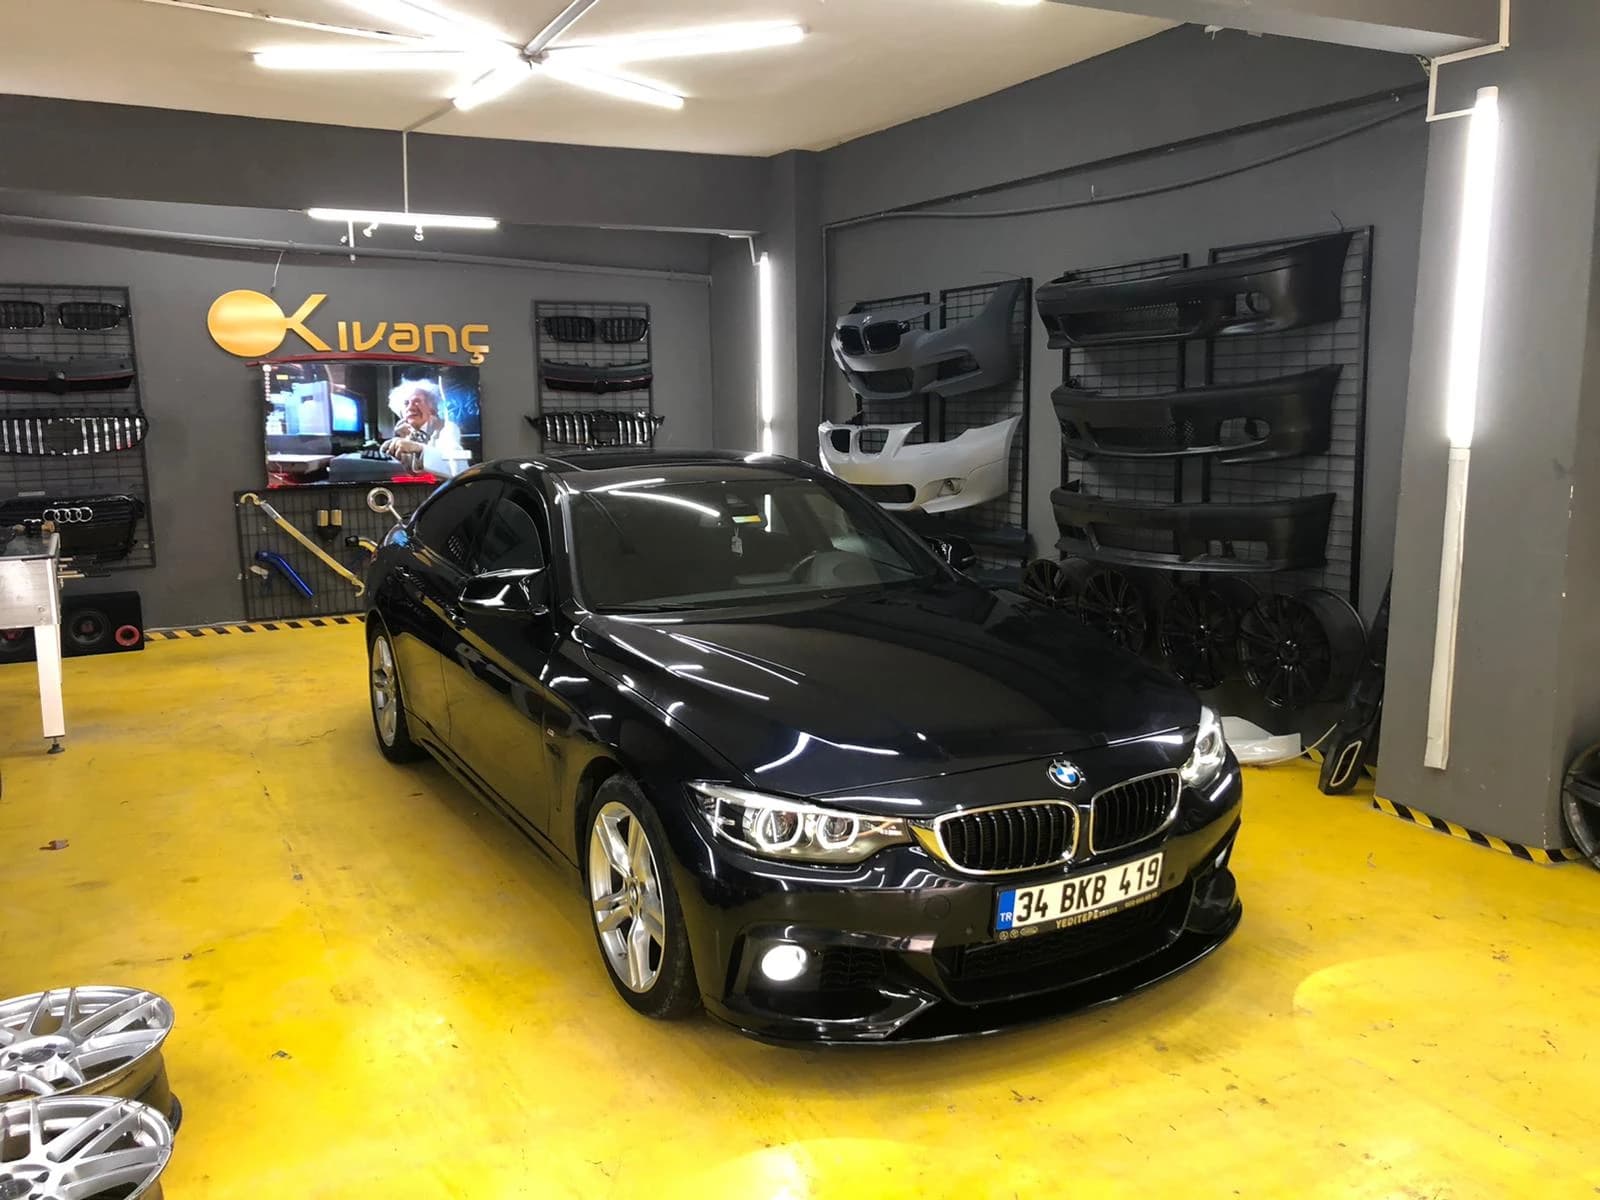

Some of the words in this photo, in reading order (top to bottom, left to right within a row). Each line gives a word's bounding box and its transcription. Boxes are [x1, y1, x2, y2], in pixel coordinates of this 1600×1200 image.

[1016, 889, 1048, 922] 34
[1060, 875, 1107, 913] BKB
[1119, 857, 1160, 895] 419
[1000, 912, 1013, 923] TR
